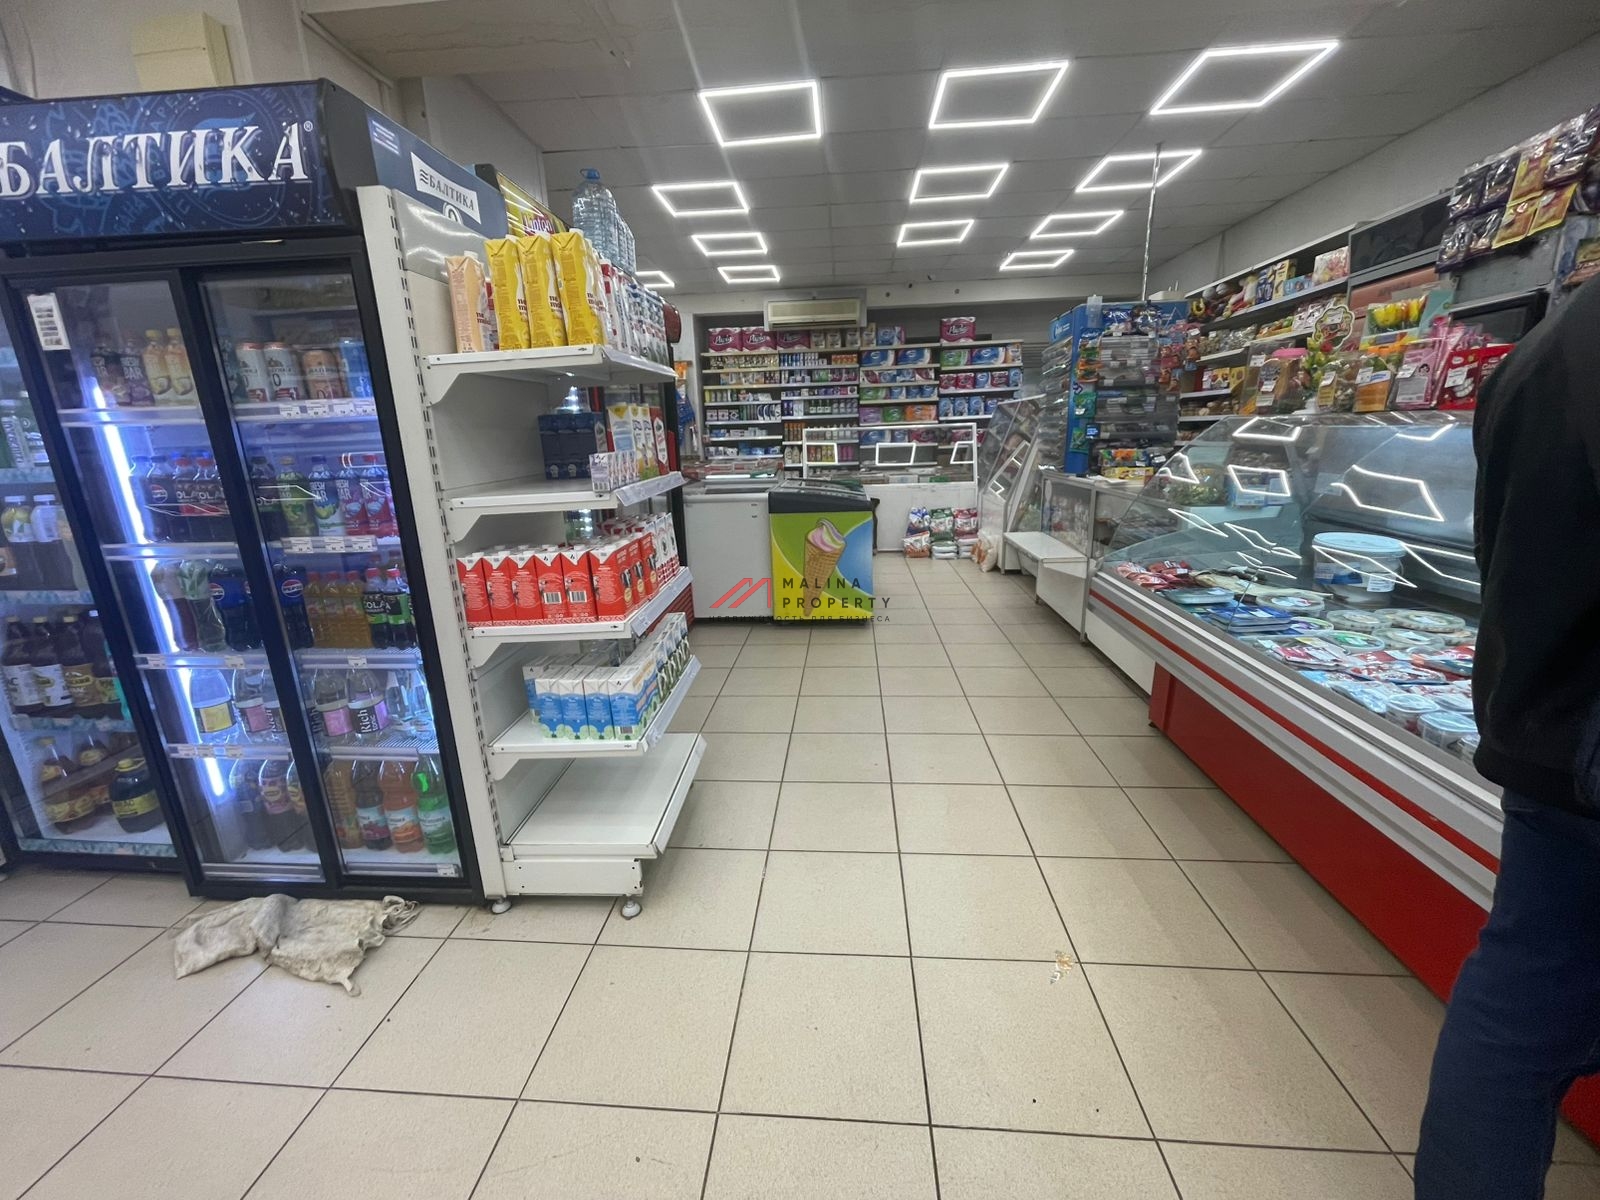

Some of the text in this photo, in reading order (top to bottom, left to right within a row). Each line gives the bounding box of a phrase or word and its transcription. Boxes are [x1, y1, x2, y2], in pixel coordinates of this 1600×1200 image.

[0, 122, 309, 197] БАЛТИКА
[429, 173, 475, 211] БАЛТИКА
[358, 708, 372, 733] Rich
[369, 714, 379, 731] tonic
